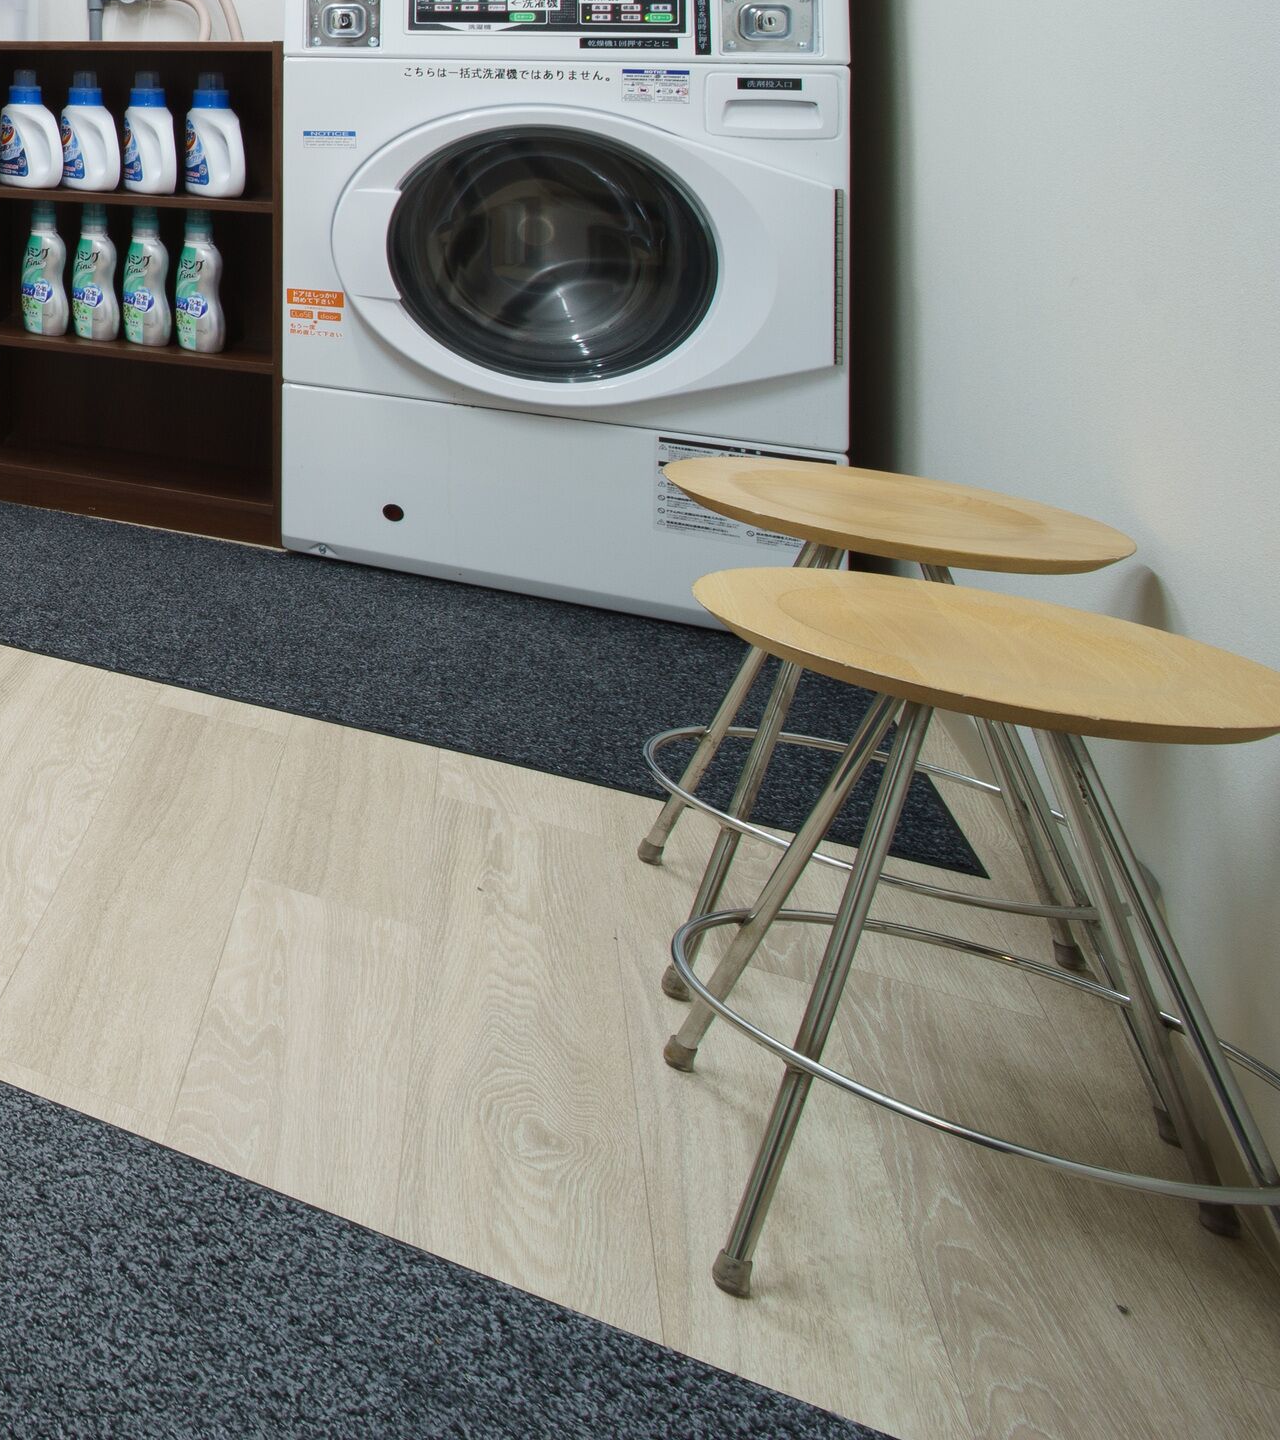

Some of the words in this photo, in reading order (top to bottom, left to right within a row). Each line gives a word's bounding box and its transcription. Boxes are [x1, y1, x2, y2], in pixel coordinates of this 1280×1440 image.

[587, 39, 670, 47] 乾燥機1回押すごとに
[403, 66, 611, 82] こちらは一括式洗濯機ではありません。
[746, 79, 793, 89] 洗剤投入口
[293, 291, 338, 300] ドアはしっかり
[292, 297, 335, 305] 閉めて下さい
